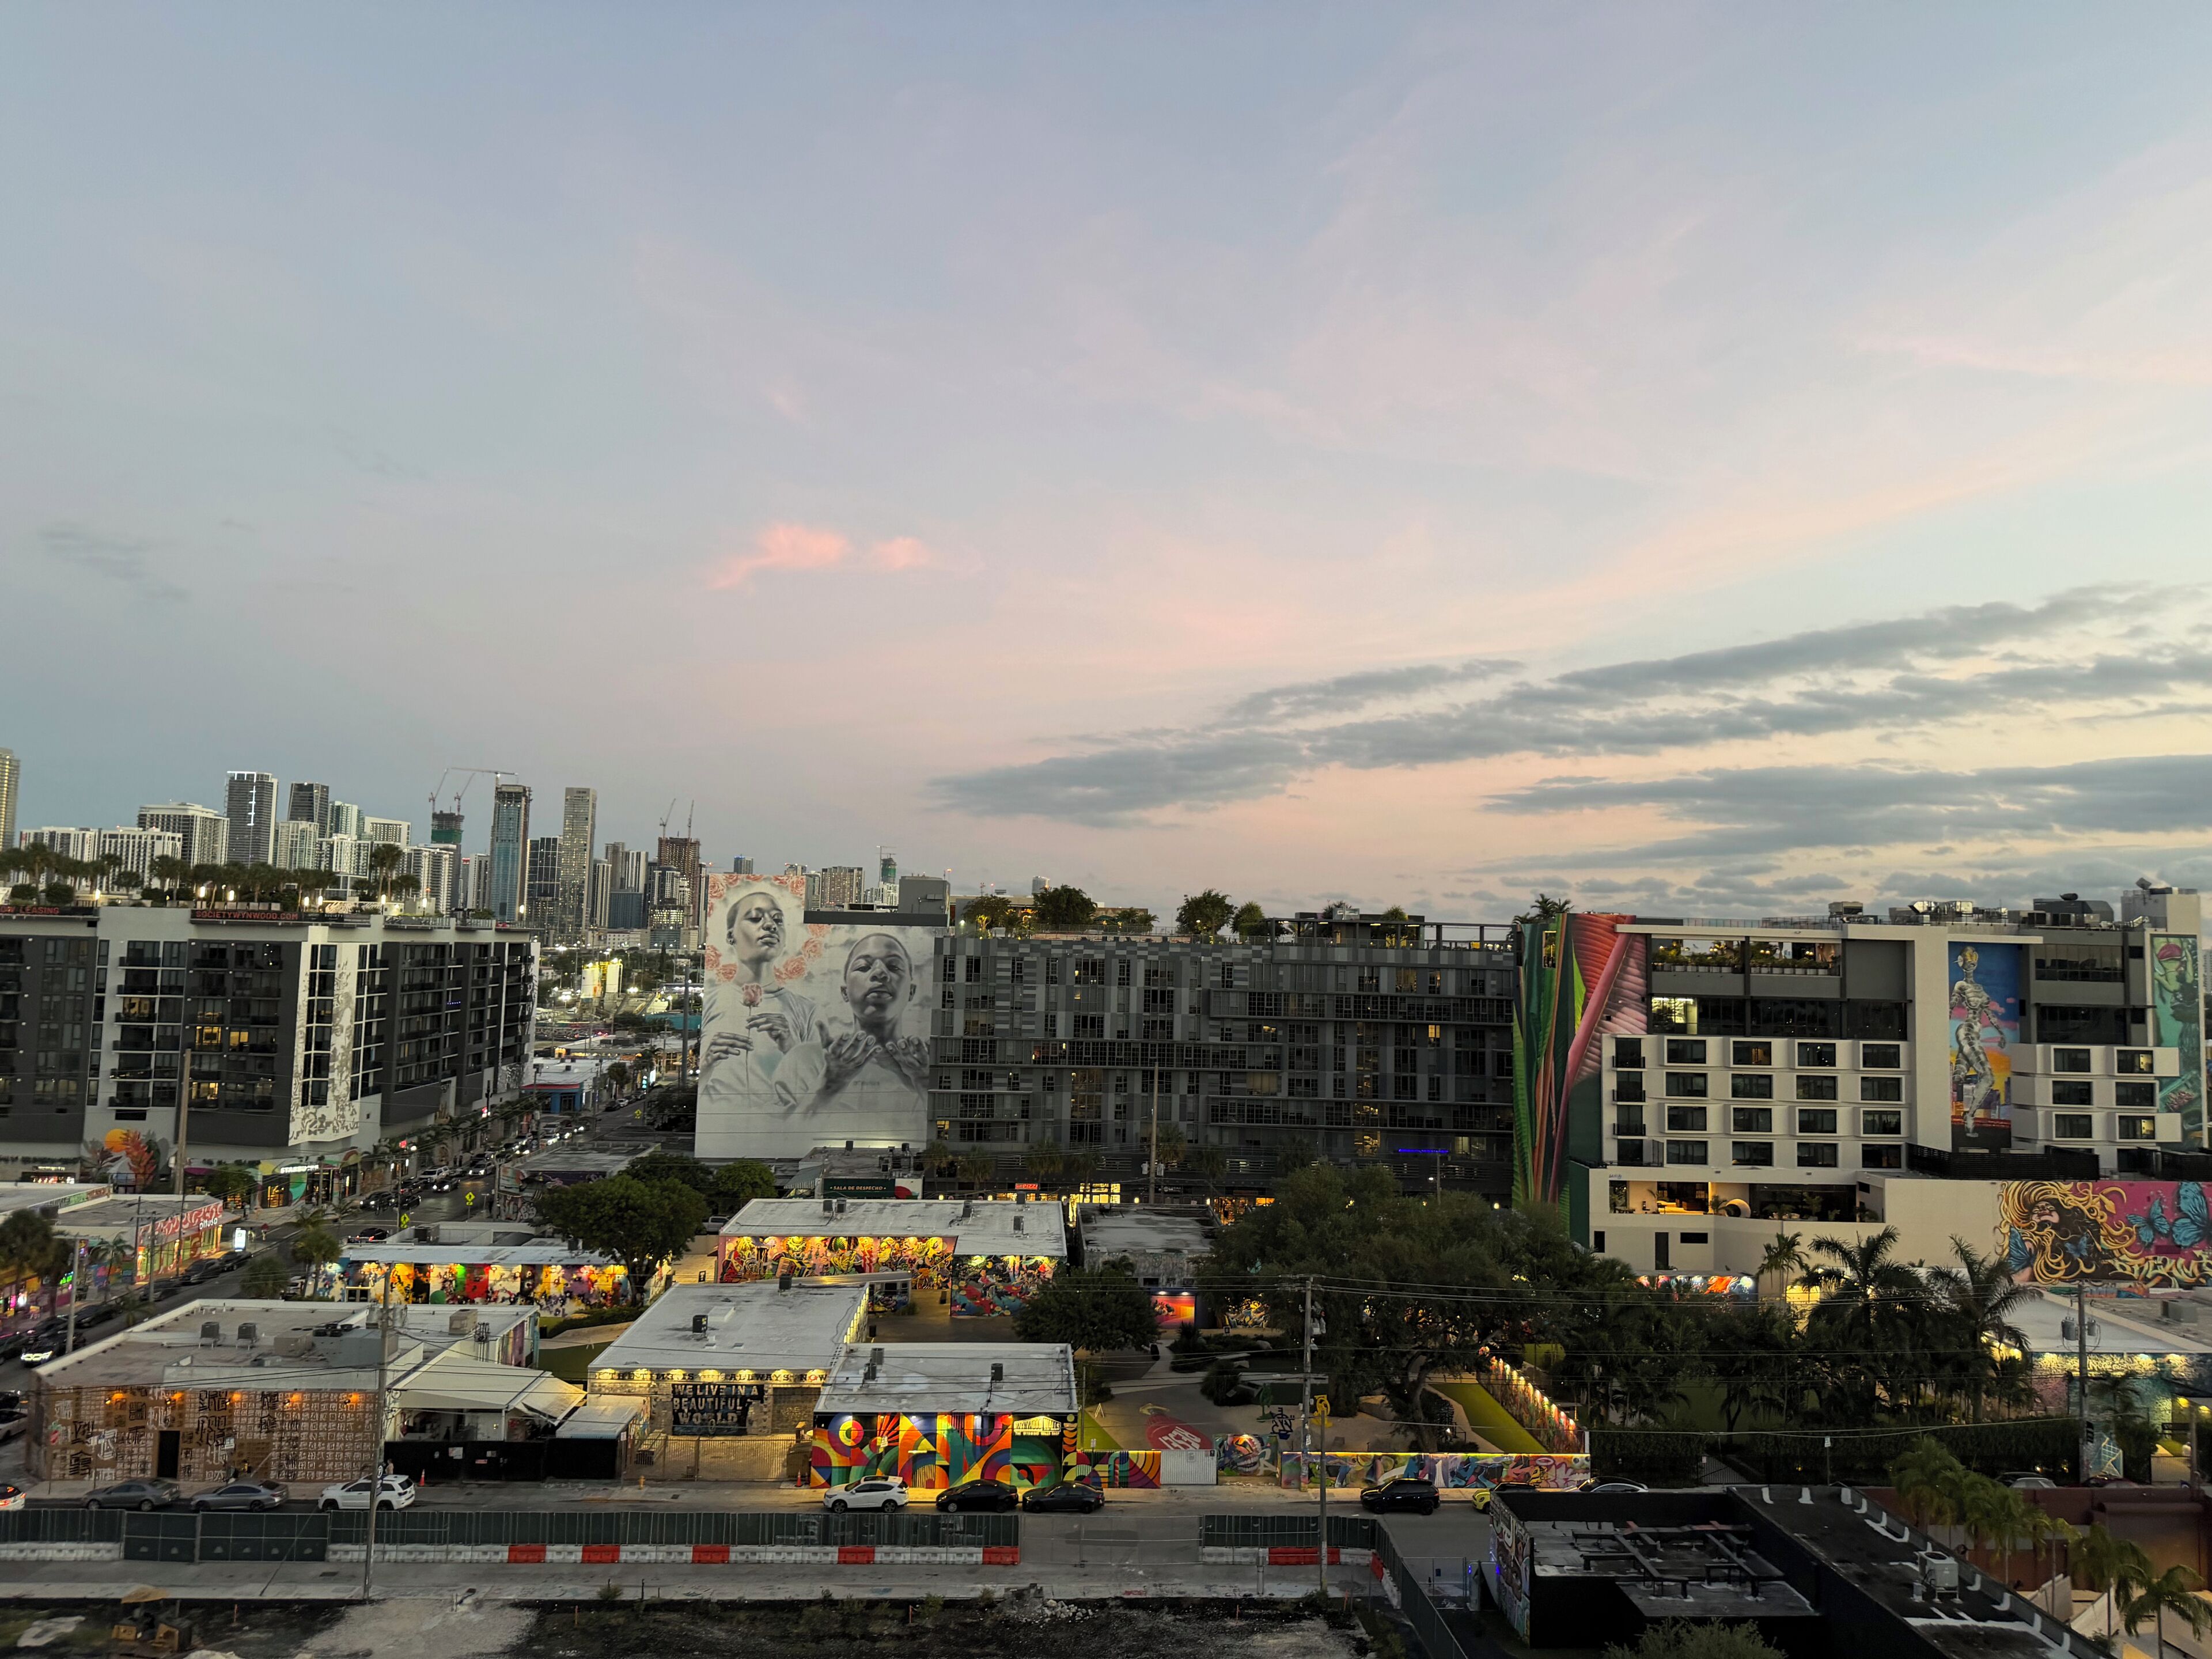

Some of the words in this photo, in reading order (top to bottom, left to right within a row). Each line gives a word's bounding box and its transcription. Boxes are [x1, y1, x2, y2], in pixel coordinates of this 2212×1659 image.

[19, 906, 60, 914] LEASING
[196, 911, 298, 920] SOCIETYWYNWOOD.COM
[800, 1374, 827, 1382] NOW
[675, 1385, 693, 1396] WE
[696, 1385, 727, 1395] LIVE
[732, 1385, 746, 1395] IN
[751, 1385, 759, 1395] A
[673, 1397, 743, 1410] BEAUTIFUL
